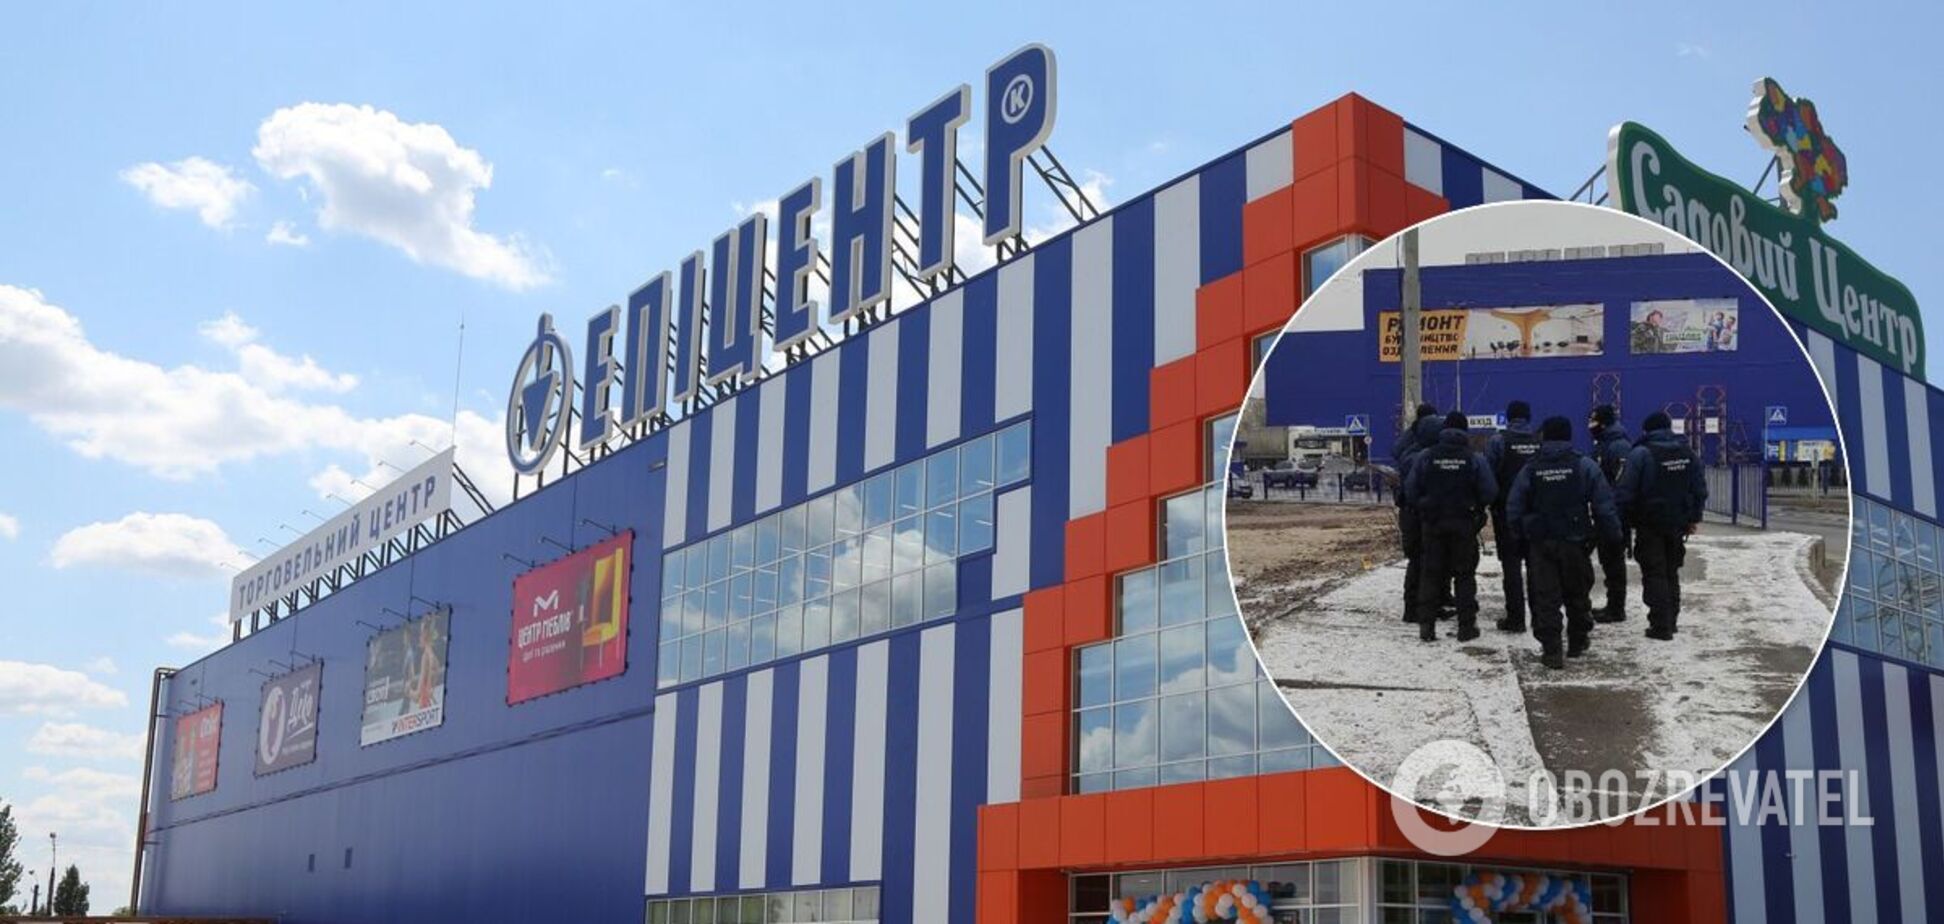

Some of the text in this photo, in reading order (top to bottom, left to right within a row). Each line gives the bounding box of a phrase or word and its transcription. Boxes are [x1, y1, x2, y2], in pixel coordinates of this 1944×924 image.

[580, 43, 1057, 450] ЕПІЦЕНТР
[1808, 236, 1917, 374] Центр
[238, 475, 436, 610] ТОРГОВЕЛЬНИЙ ЦЕНТР
[518, 622, 541, 648] ЦЕНТР
